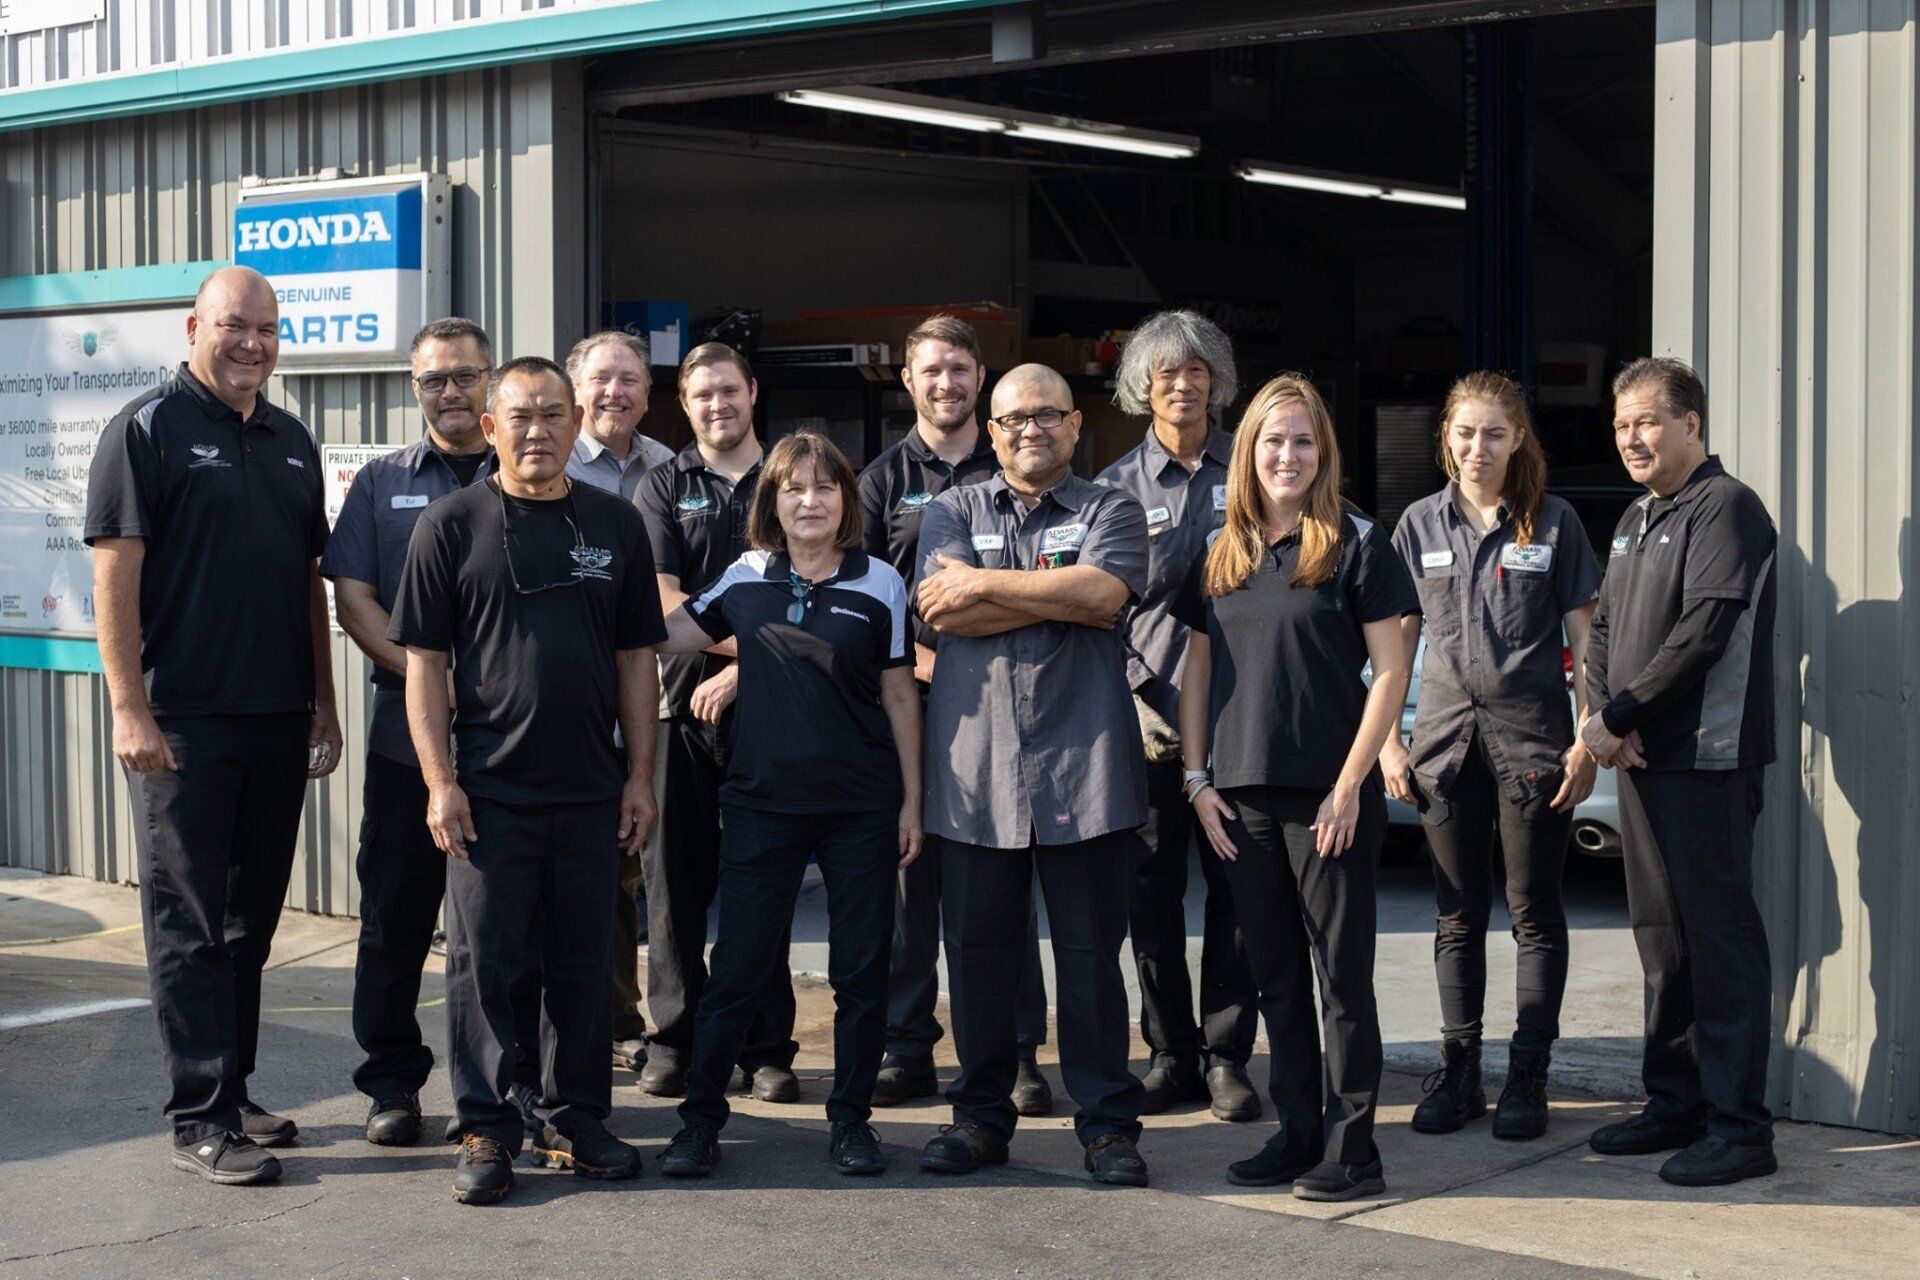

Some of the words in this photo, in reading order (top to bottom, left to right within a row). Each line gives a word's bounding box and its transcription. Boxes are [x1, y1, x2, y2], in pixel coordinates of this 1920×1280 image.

[238, 211, 392, 252] HONDA
[275, 286, 353, 303] GENUINE
[278, 313, 379, 345] ARTS
[45, 372, 70, 391] Your
[73, 366, 156, 392] Transportation
[8, 419, 36, 435] 36000
[38, 418, 57, 434] mile
[60, 418, 99, 436] warranty
[25, 442, 55, 460] Locally
[58, 441, 91, 457] Owned
[329, 453, 364, 464] PRIVATE
[25, 467, 44, 481] Free
[47, 465, 69, 480] Local
[46, 536, 65, 551] AAA
